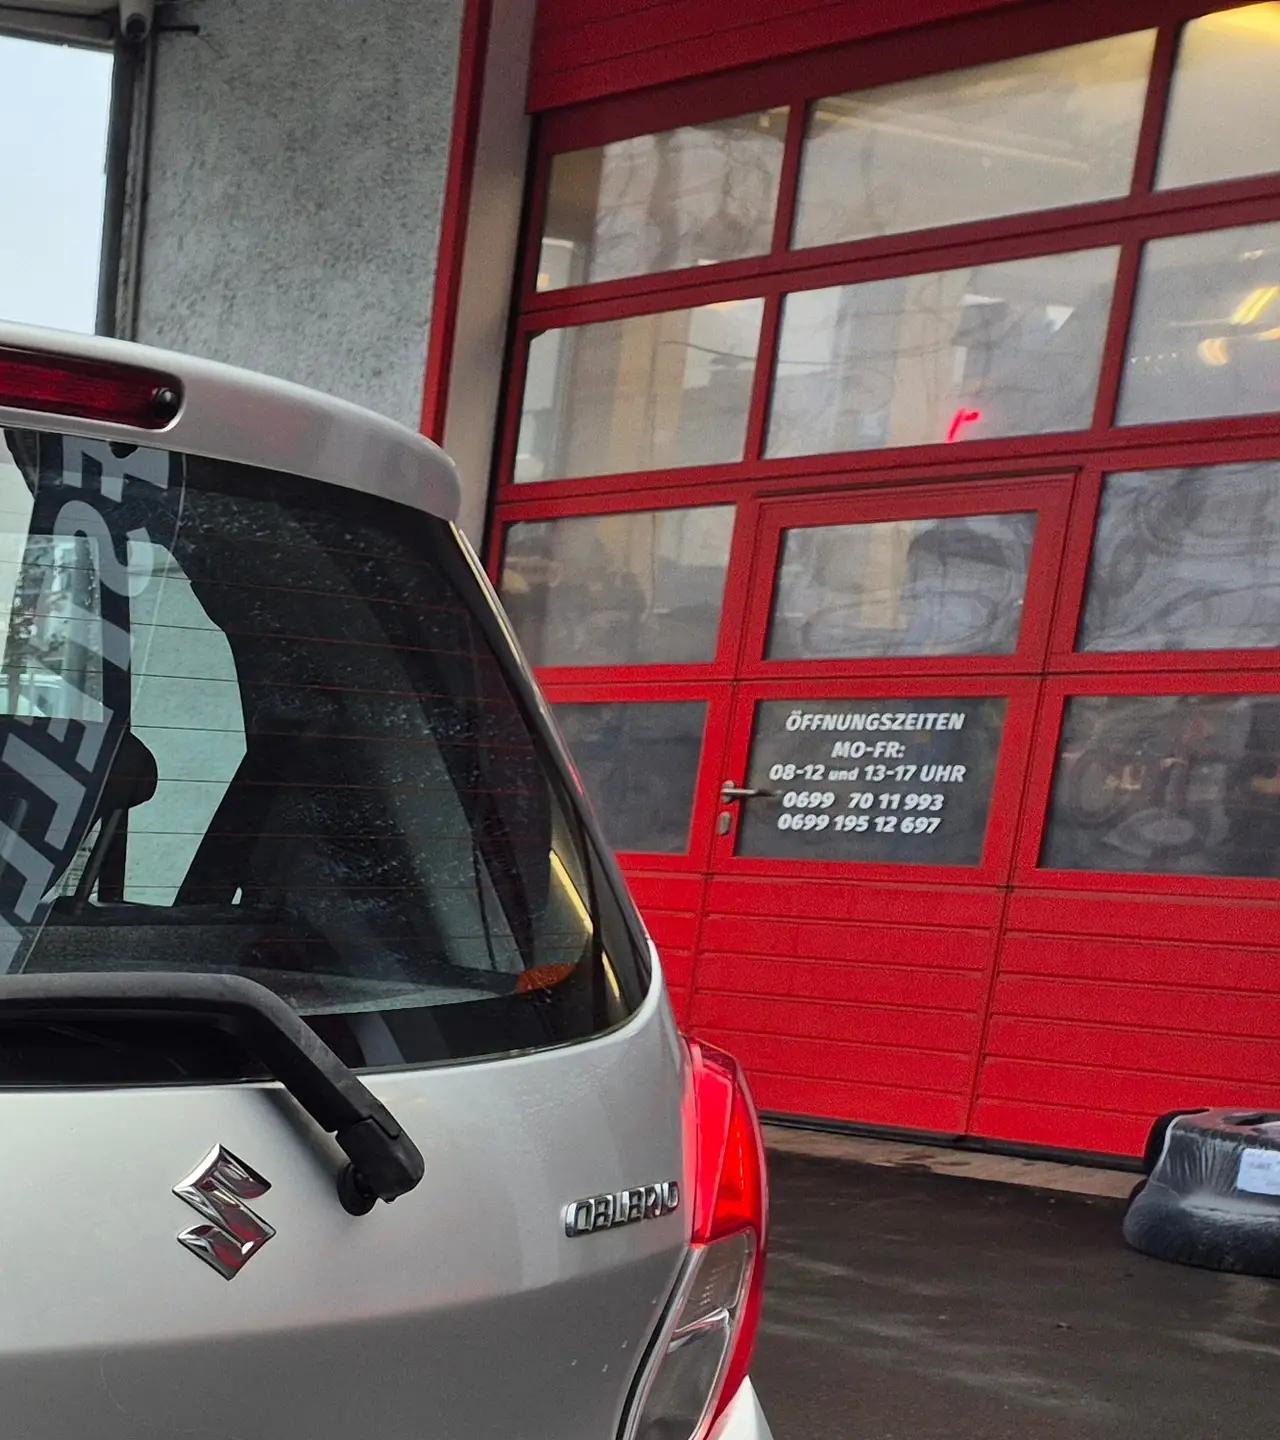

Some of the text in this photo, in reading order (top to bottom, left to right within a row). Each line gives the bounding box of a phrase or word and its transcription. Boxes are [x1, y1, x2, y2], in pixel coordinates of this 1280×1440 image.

[785, 709, 965, 732] ÖFFNUNGSZEITEN
[830, 741, 907, 759] MO-FR:
[768, 764, 967, 783] 08-12 und 13-17 UHR
[782, 791, 945, 811] 0699 70 11 993
[777, 813, 942, 834] 0699 195 12 697
